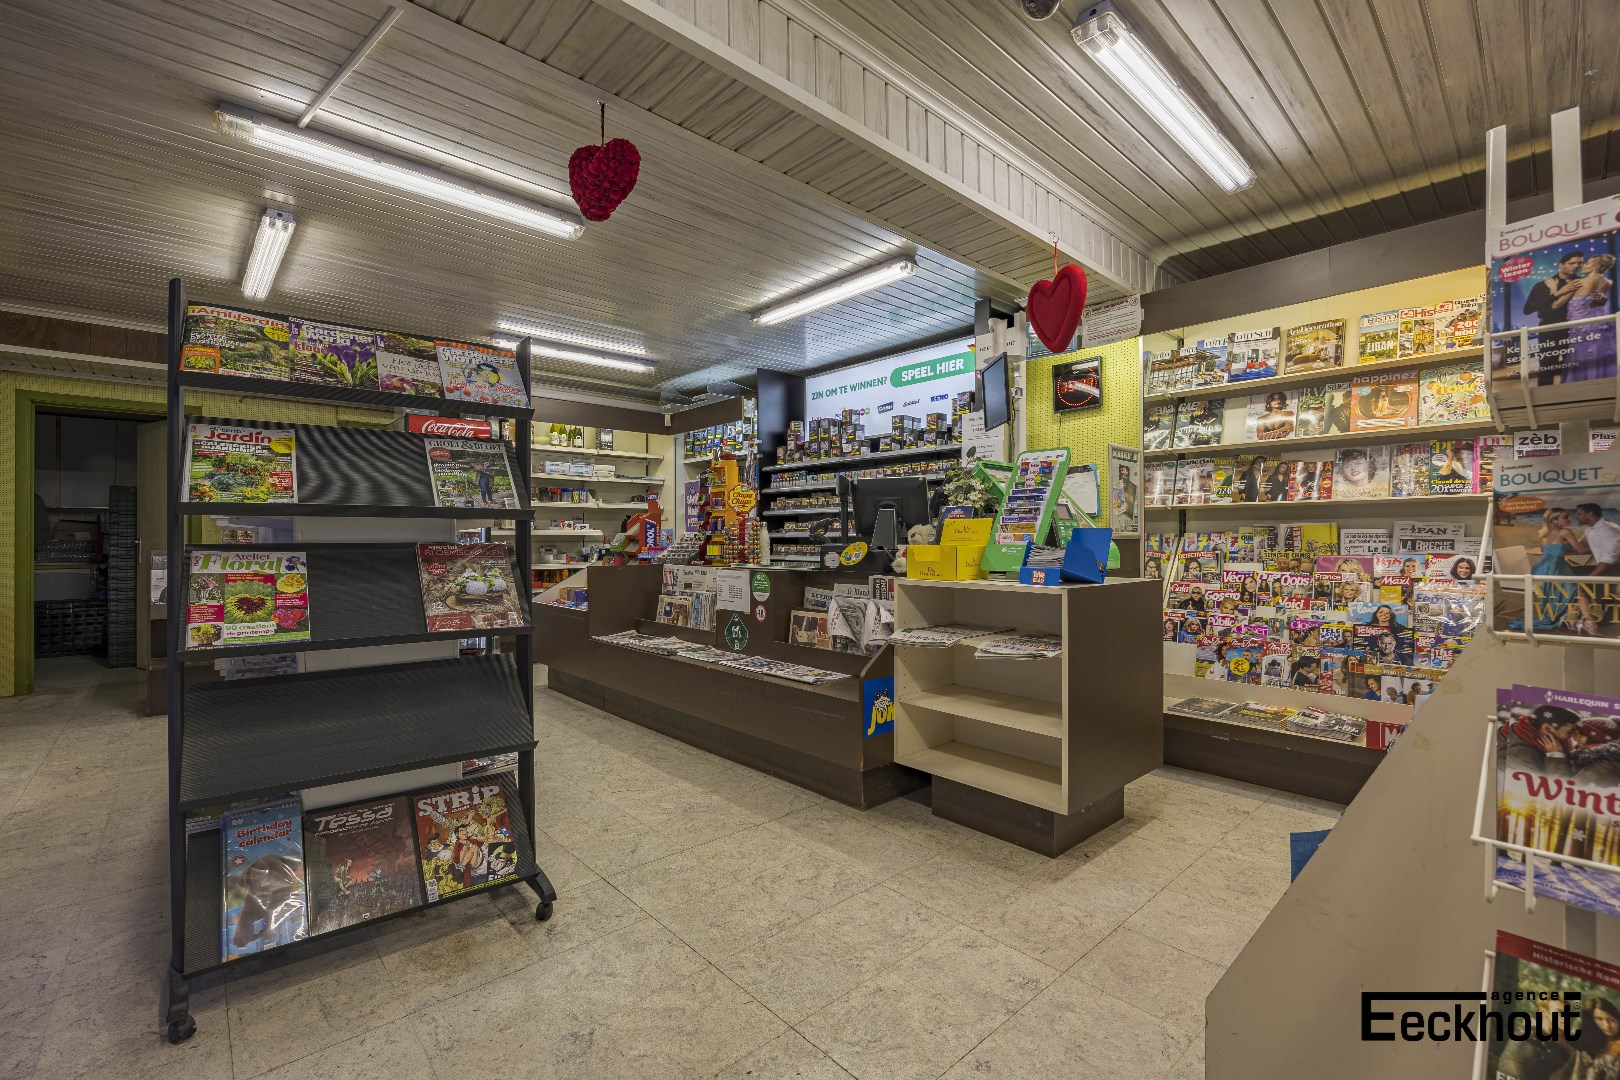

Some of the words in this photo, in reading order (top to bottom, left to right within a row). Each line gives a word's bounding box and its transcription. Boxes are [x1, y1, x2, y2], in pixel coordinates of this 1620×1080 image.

[1500, 212, 1607, 252] BOUQUET
[1501, 262, 1532, 273] Winter
[1558, 333, 1583, 346] met
[1585, 332, 1602, 341] de
[1534, 347, 1595, 361] tycoon
[901, 363, 934, 382] SPEEL
[936, 358, 965, 374] HIER
[1353, 372, 1418, 385] happinez
[811, 388, 824, 401] ZIN
[825, 386, 838, 398] OM
[838, 384, 848, 395] TE
[849, 376, 888, 392] WINNEN?
[1432, 380, 1480, 396] flow
[204, 431, 272, 444] Jardin
[1500, 466, 1604, 487] BOUQUET
[731, 497, 752, 506] Chups
[732, 491, 753, 499] Chupa
[199, 553, 284, 573] Floral
[232, 553, 272, 561] Atelier
[1315, 573, 1342, 582] France
[1208, 616, 1235, 627] Public
[1554, 693, 1609, 709] HARLEQUIN
[236, 818, 293, 839] Birthday
[238, 828, 293, 848] calendar
